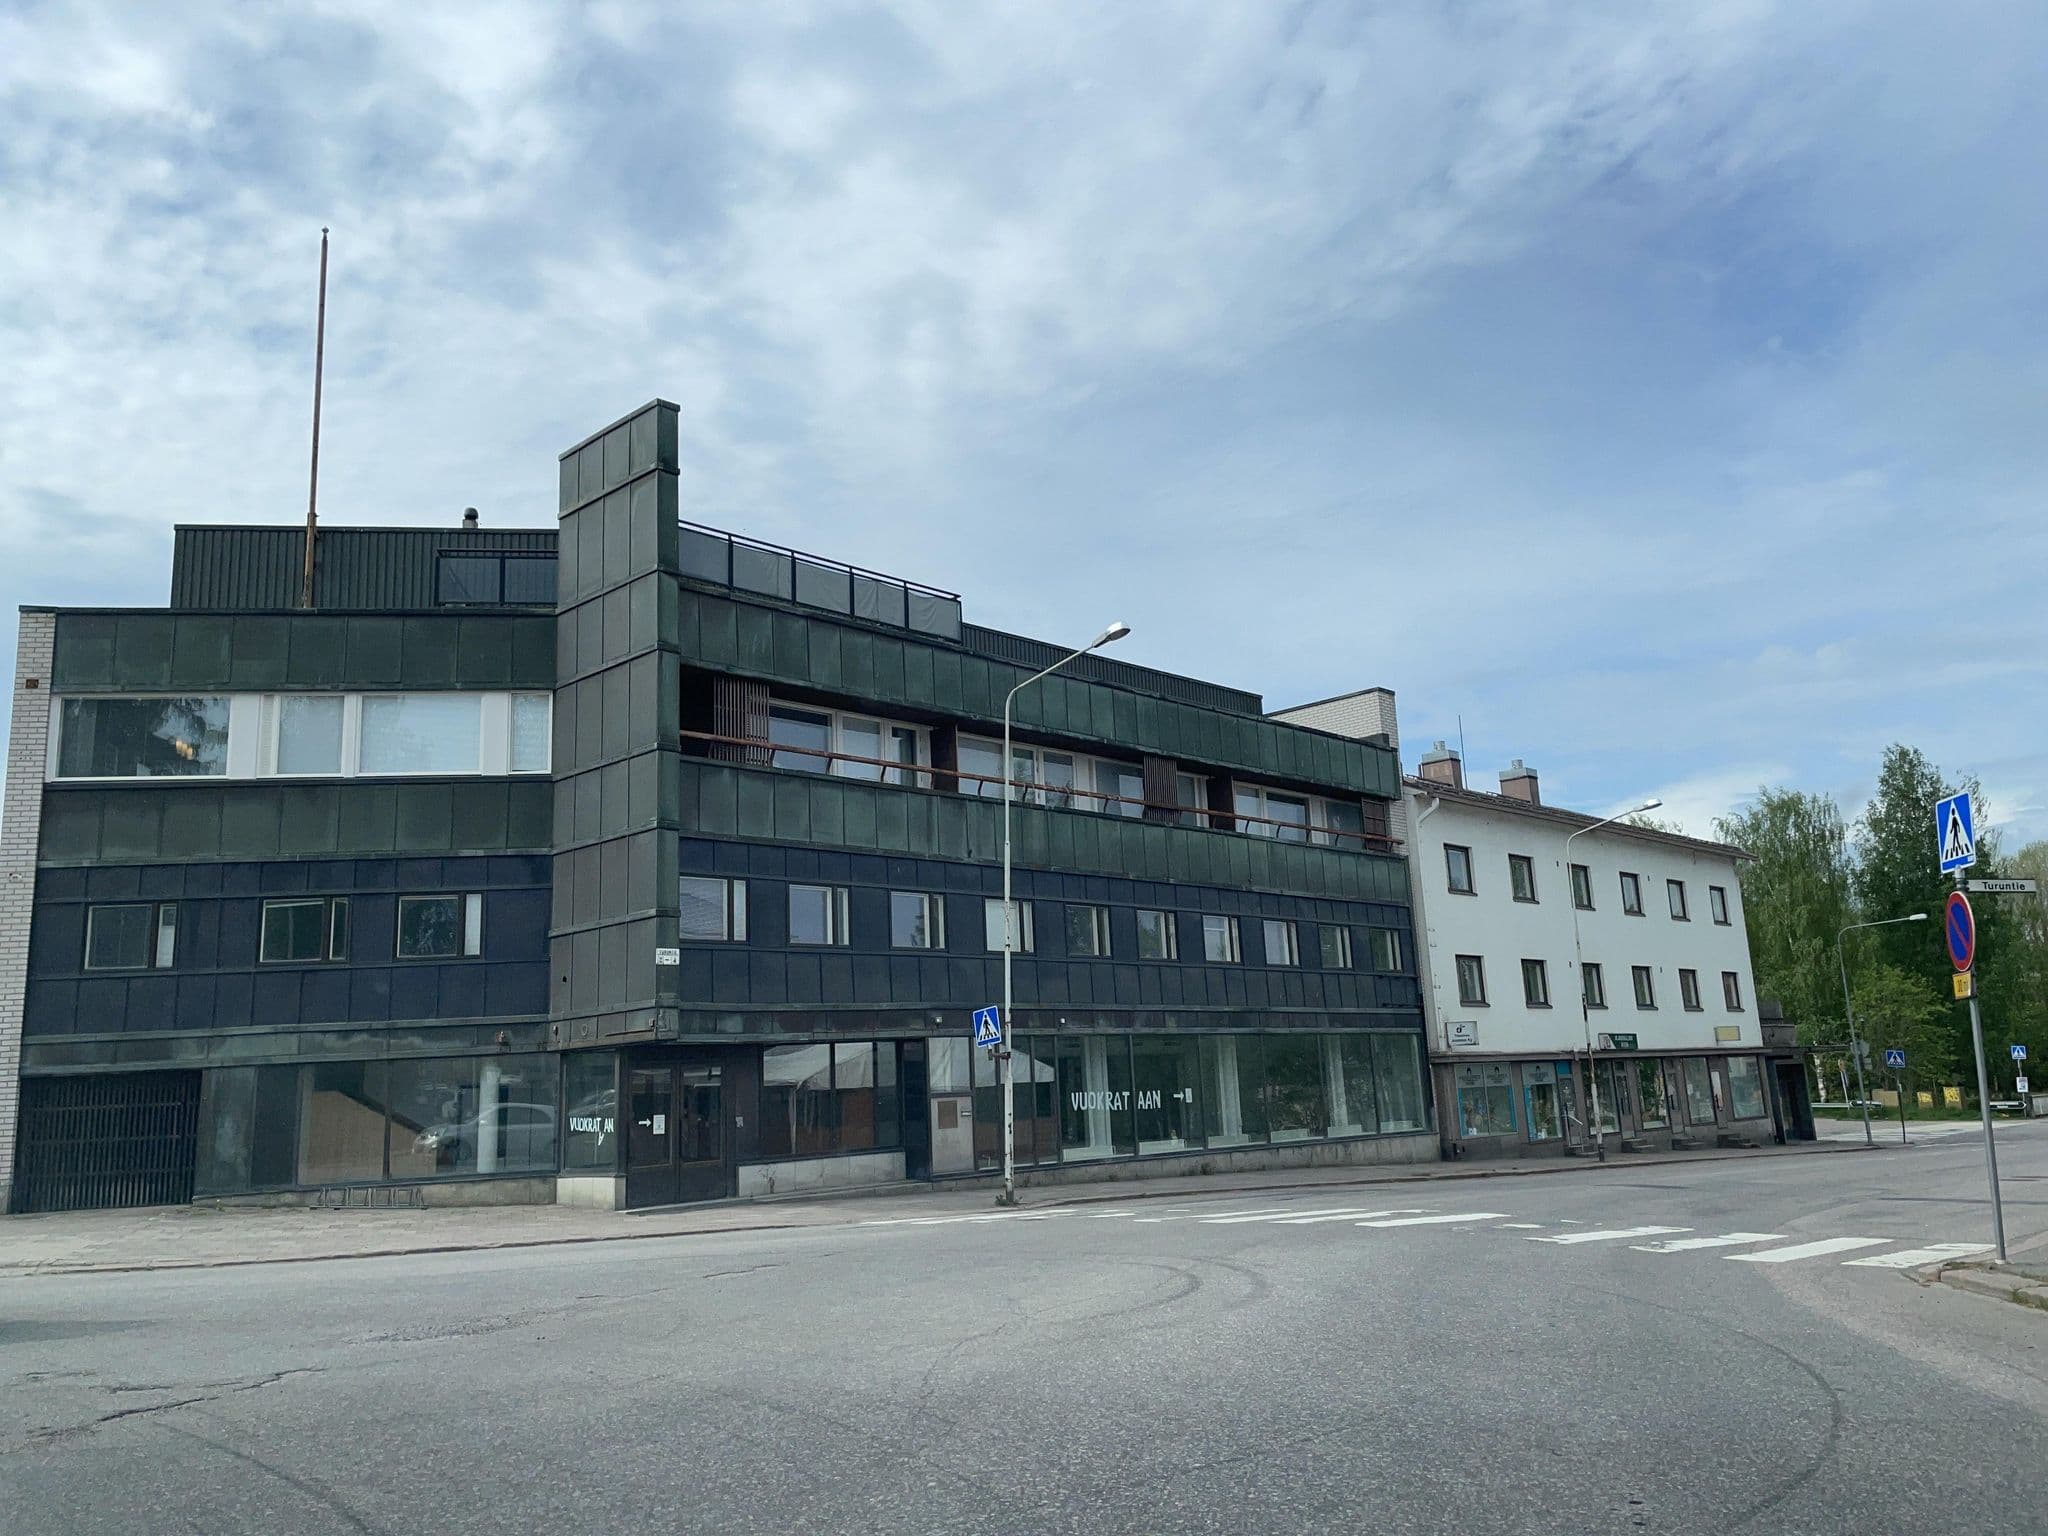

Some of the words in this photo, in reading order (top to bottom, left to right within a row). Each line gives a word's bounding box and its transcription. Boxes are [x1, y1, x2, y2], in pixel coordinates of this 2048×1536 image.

[1981, 881, 2026, 891] Turuntie
[1071, 1091, 1130, 1112] VUOKRAT
[1137, 1090, 1161, 1110] AAN
[569, 1117, 601, 1133] VUOKRAT
